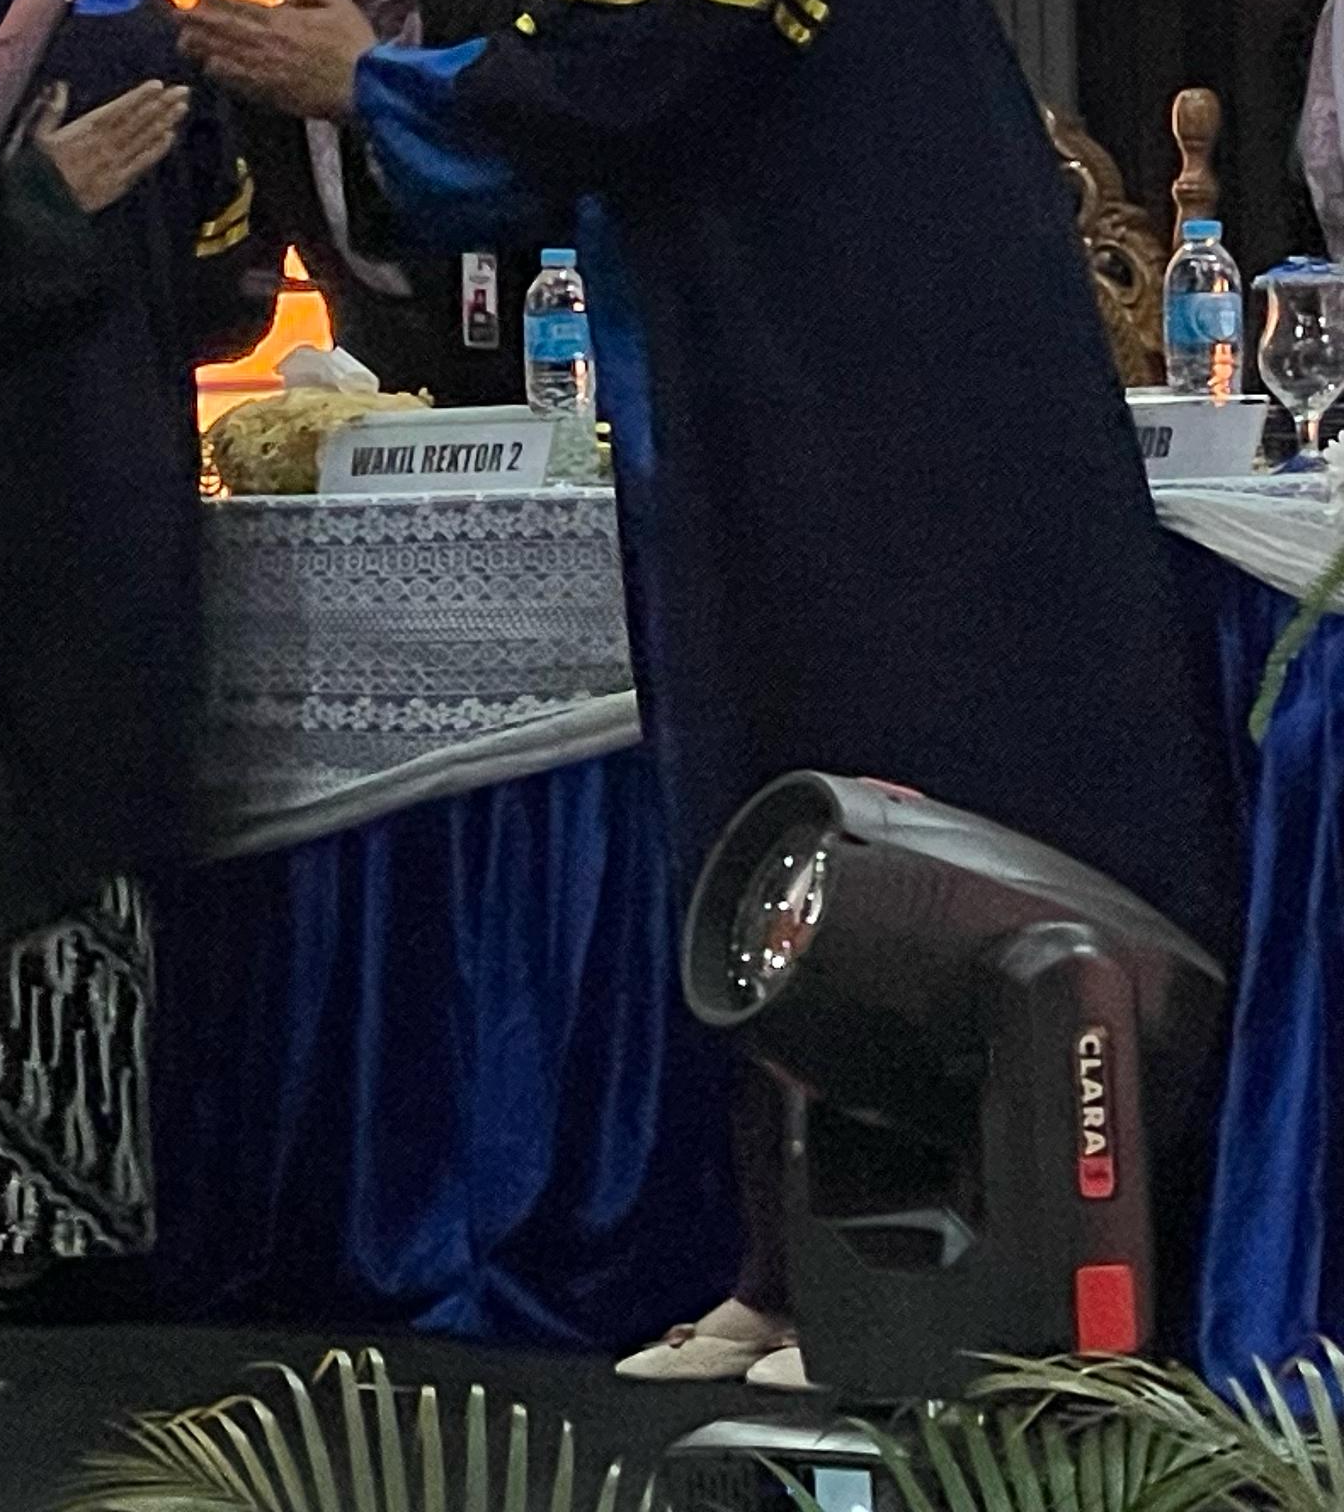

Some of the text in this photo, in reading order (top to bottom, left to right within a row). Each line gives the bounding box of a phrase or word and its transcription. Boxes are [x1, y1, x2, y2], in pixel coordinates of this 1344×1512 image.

[351, 442, 524, 476] WAKIL REKTOR 2
[1078, 1034, 1107, 1156] CLARA
